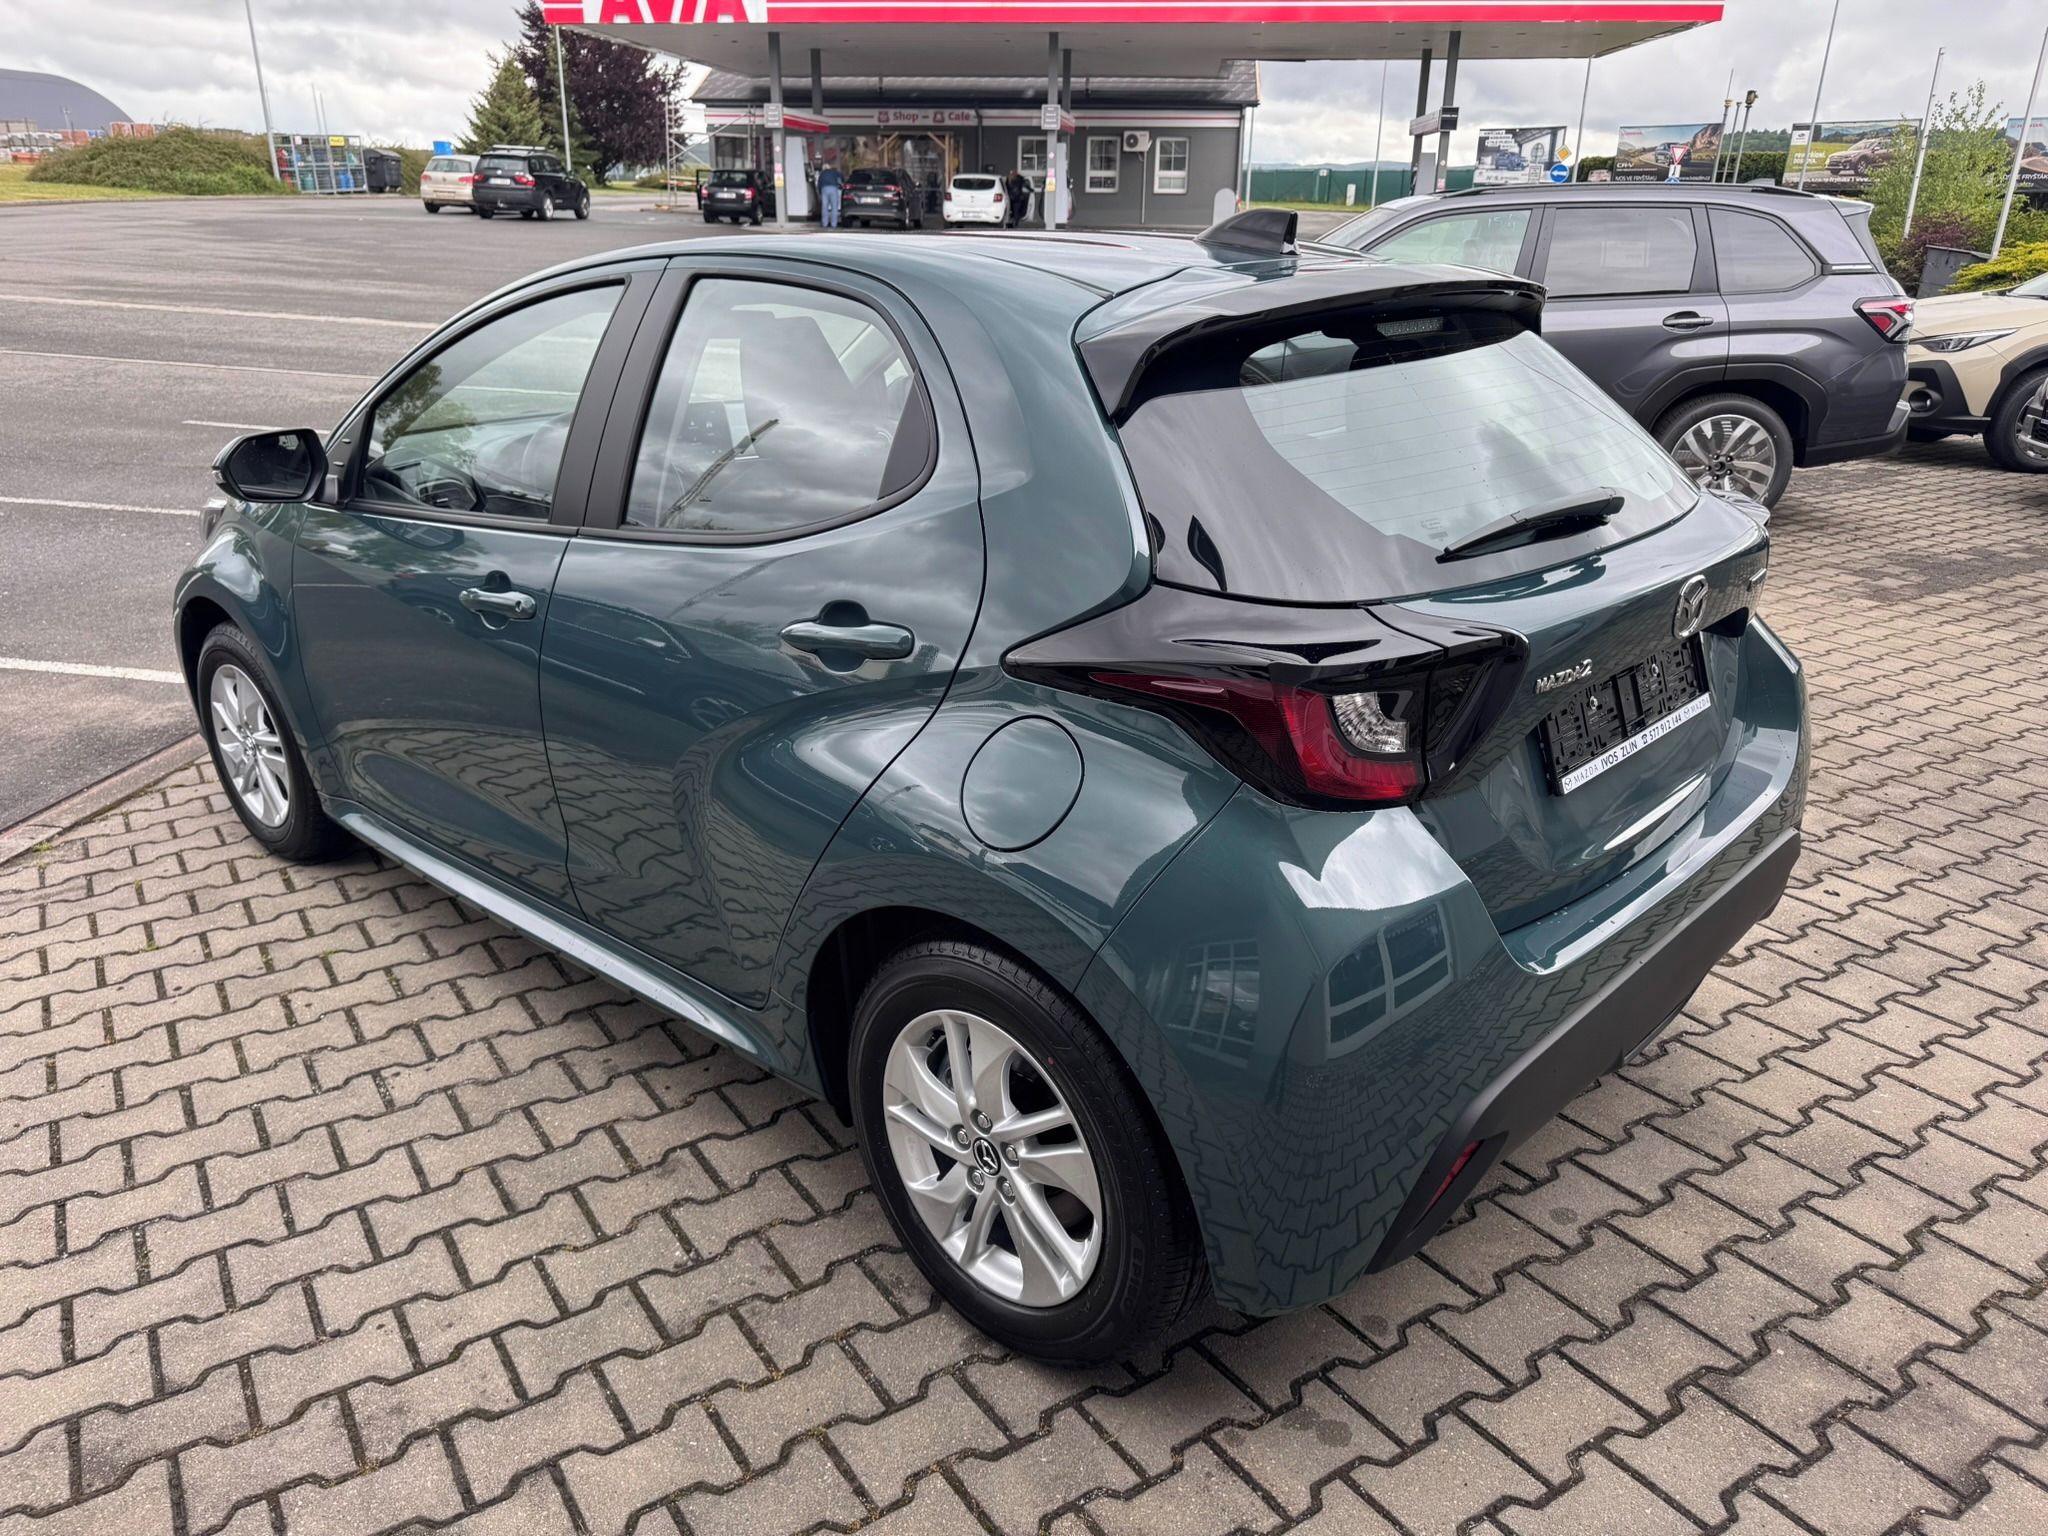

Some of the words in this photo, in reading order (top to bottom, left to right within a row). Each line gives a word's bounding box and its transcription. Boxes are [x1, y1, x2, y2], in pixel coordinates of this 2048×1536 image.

[893, 111, 919, 123] Shop
[948, 111, 971, 121] Café
[1536, 658, 1592, 694] MAZDA2
[1573, 764, 1599, 784] MAZDA
[1600, 751, 1619, 769] IVOS
[1620, 739, 1638, 758] ZLÍN
[1649, 726, 1660, 741] 577
[1660, 720, 1672, 734] 912
[1672, 713, 1682, 727] 144
[1690, 696, 1710, 714] MAZDA
